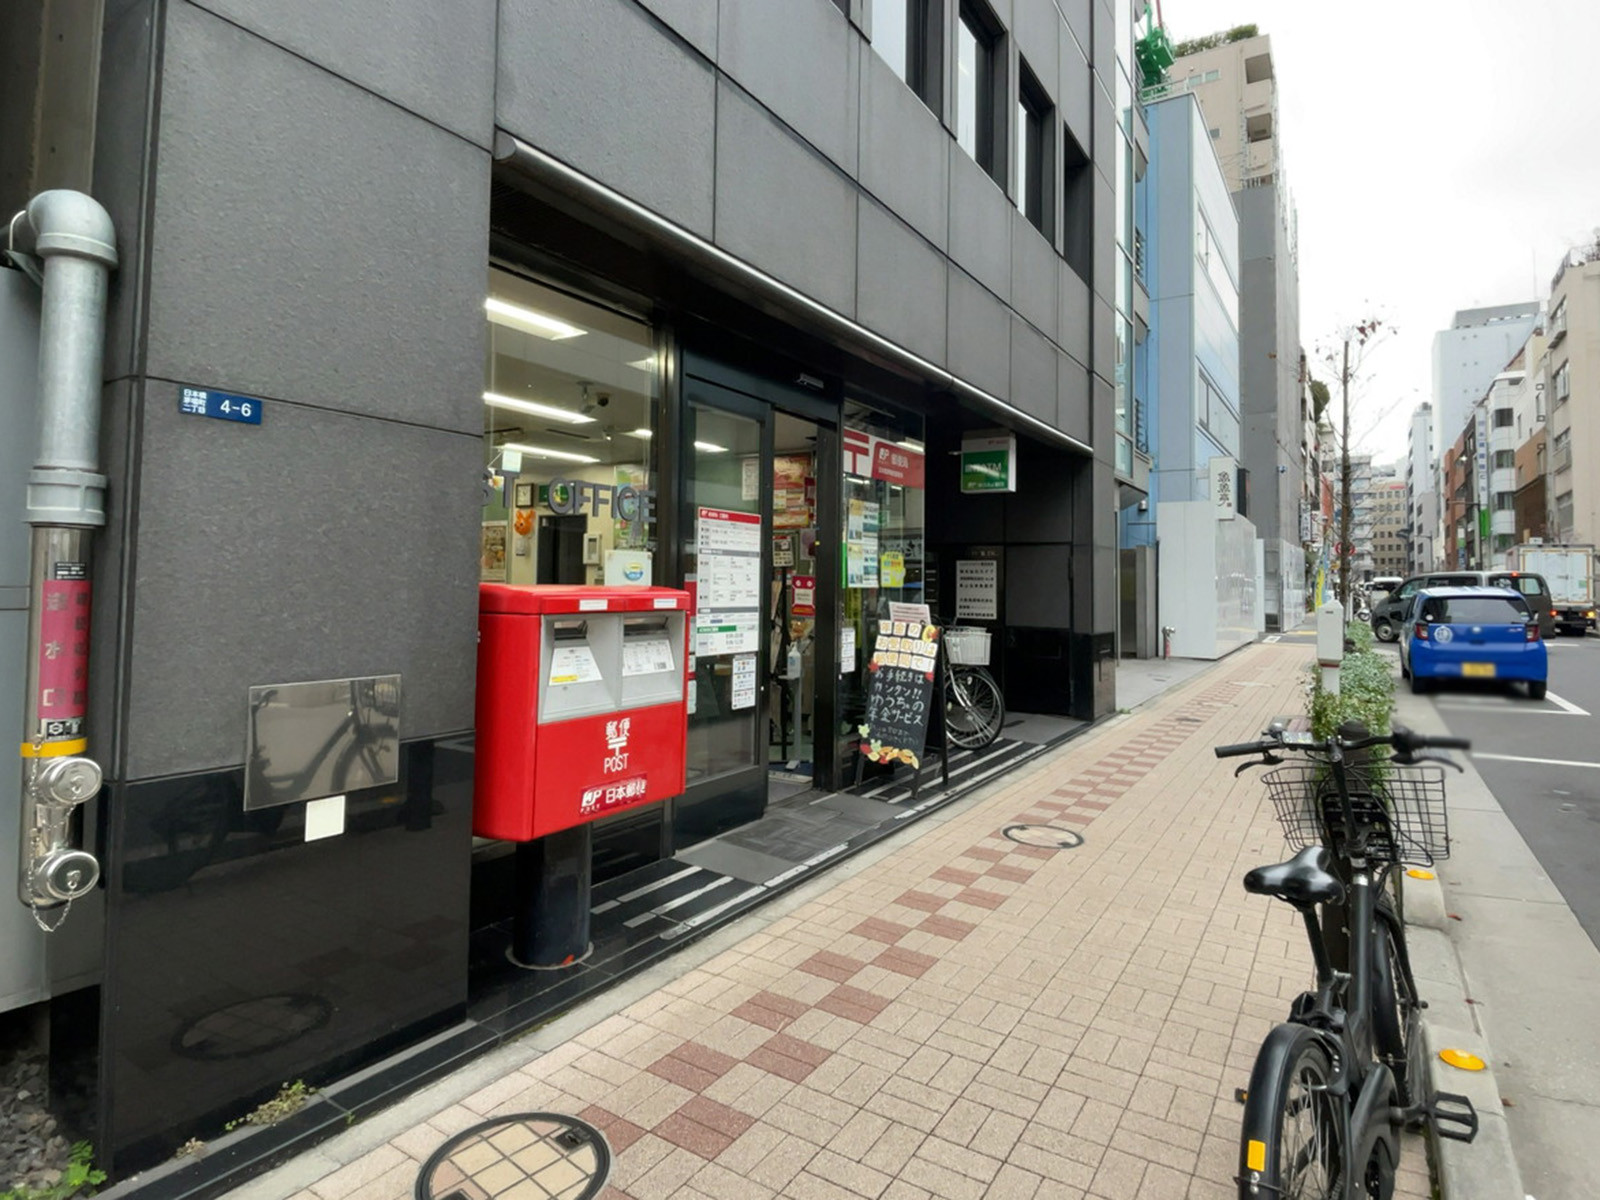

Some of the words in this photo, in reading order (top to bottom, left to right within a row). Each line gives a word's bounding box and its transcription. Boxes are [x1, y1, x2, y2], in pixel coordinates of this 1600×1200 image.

[220, 400, 252, 417] 4-6
[548, 477, 657, 524] OFFICE
[875, 668, 924, 684] お手続きは
[606, 717, 631, 740] 郵便
[868, 707, 924, 727] 年金サービス
[603, 752, 629, 775] POST
[605, 778, 647, 804] 日本郵便
